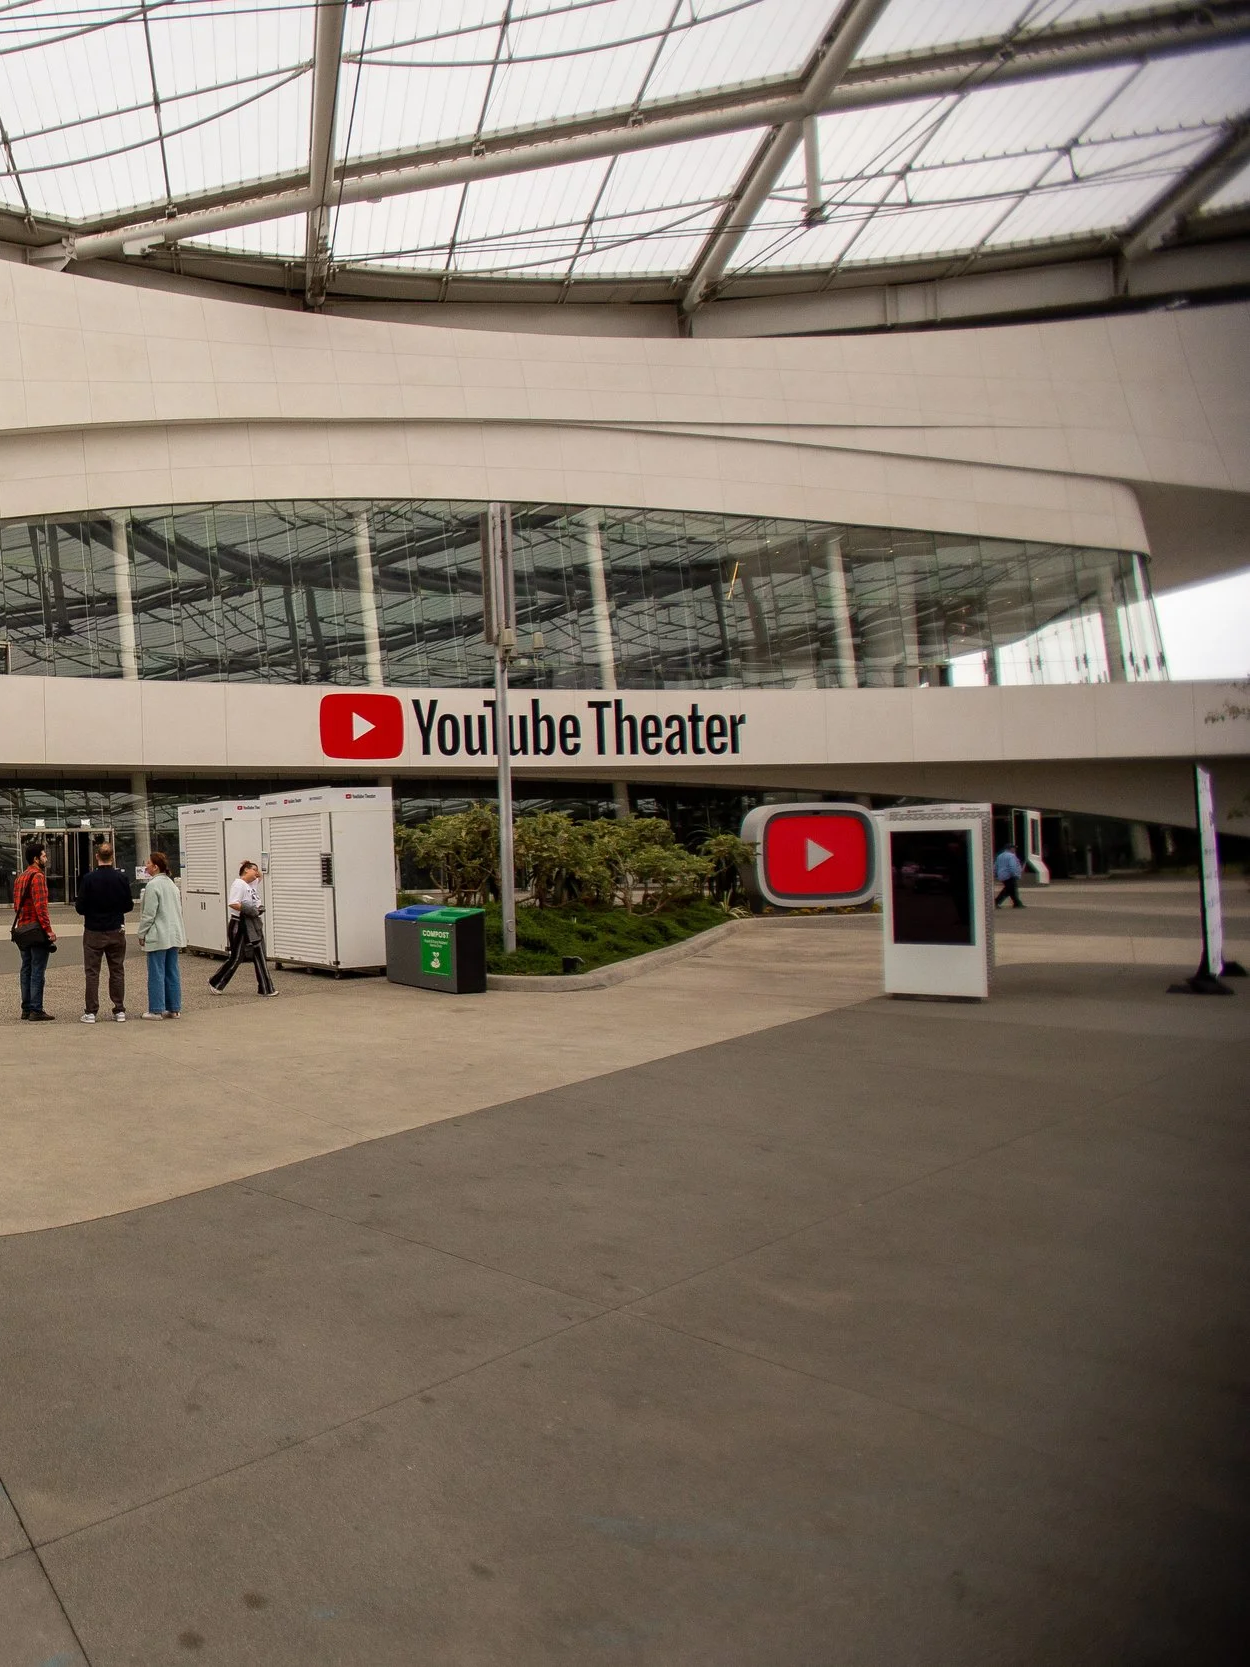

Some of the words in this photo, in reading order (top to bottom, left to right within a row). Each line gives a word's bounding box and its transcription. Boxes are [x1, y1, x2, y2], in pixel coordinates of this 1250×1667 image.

[411, 698, 581, 756] YouTube
[588, 699, 746, 756] Theater
[422, 930, 449, 938] COMPOST
